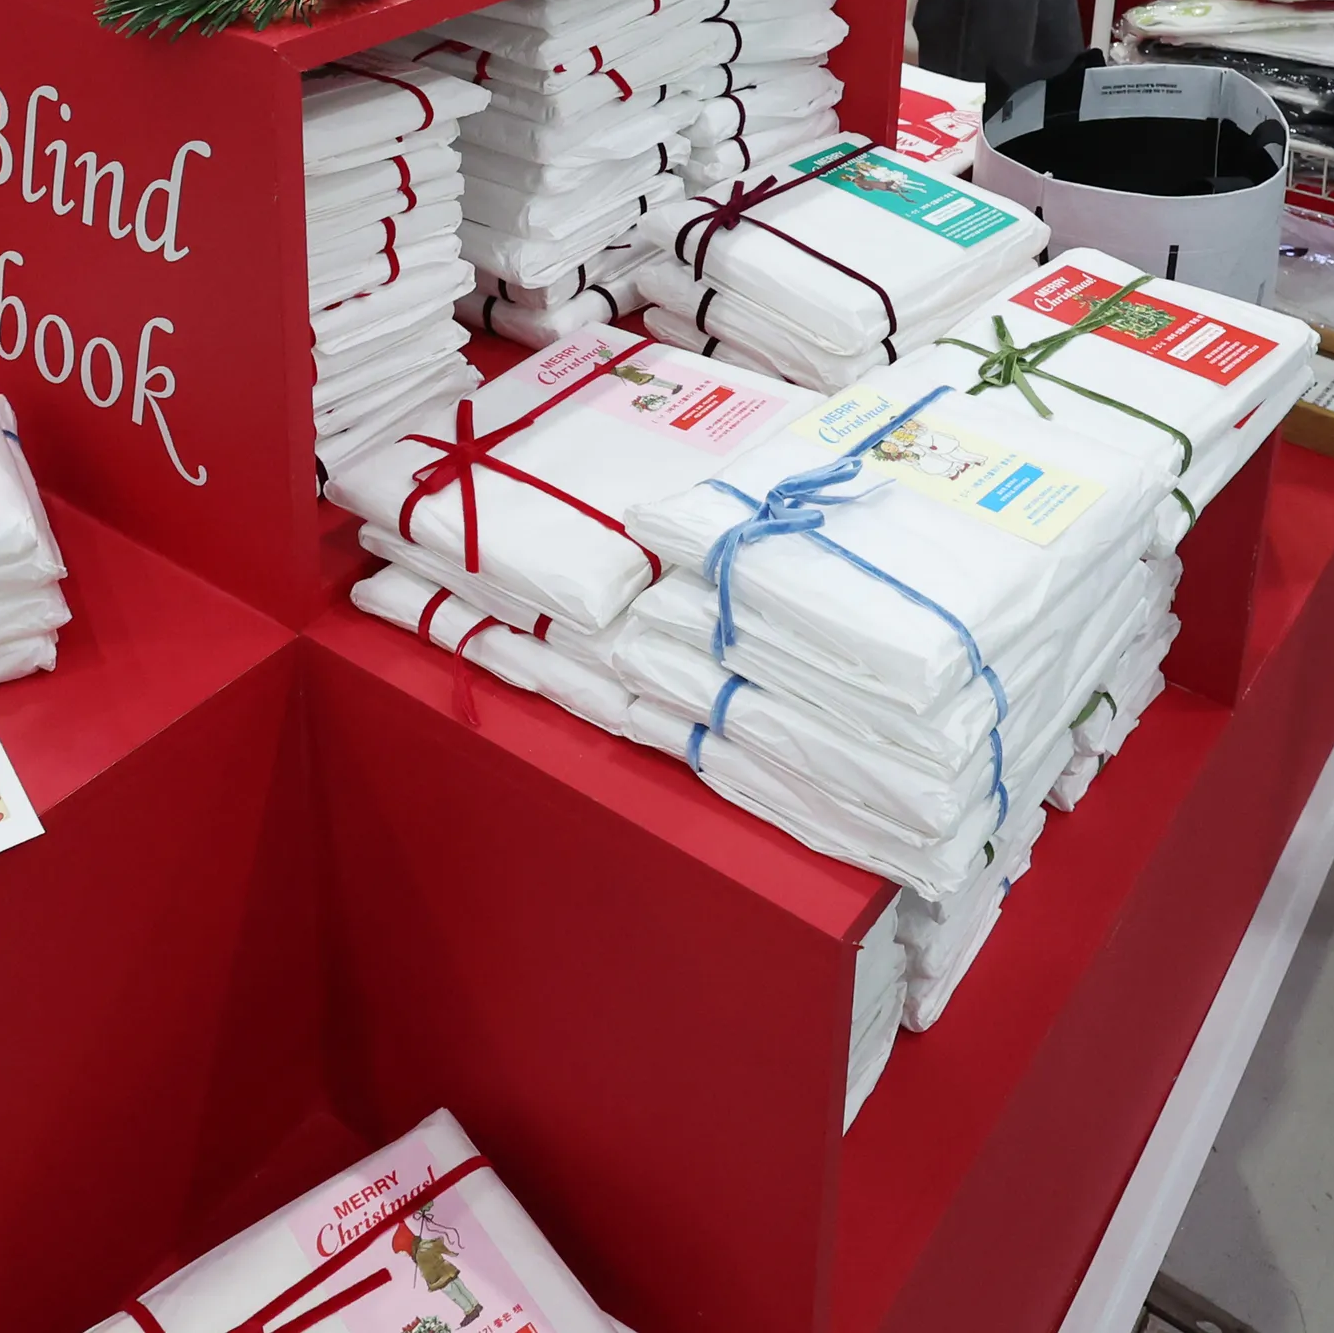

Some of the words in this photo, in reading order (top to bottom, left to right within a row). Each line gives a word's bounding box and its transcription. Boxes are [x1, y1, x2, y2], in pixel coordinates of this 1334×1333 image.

[1033, 273, 1097, 312] Christmas!
[1035, 276, 1070, 298] MERRY
[537, 339, 610, 385] Christmas!
[540, 344, 581, 369] MERRY
[818, 395, 893, 444] Christmas!
[820, 400, 861, 426] MERRY
[333, 1170, 400, 1220] MERRY
[493, 1312, 512, 1329] 좋은
